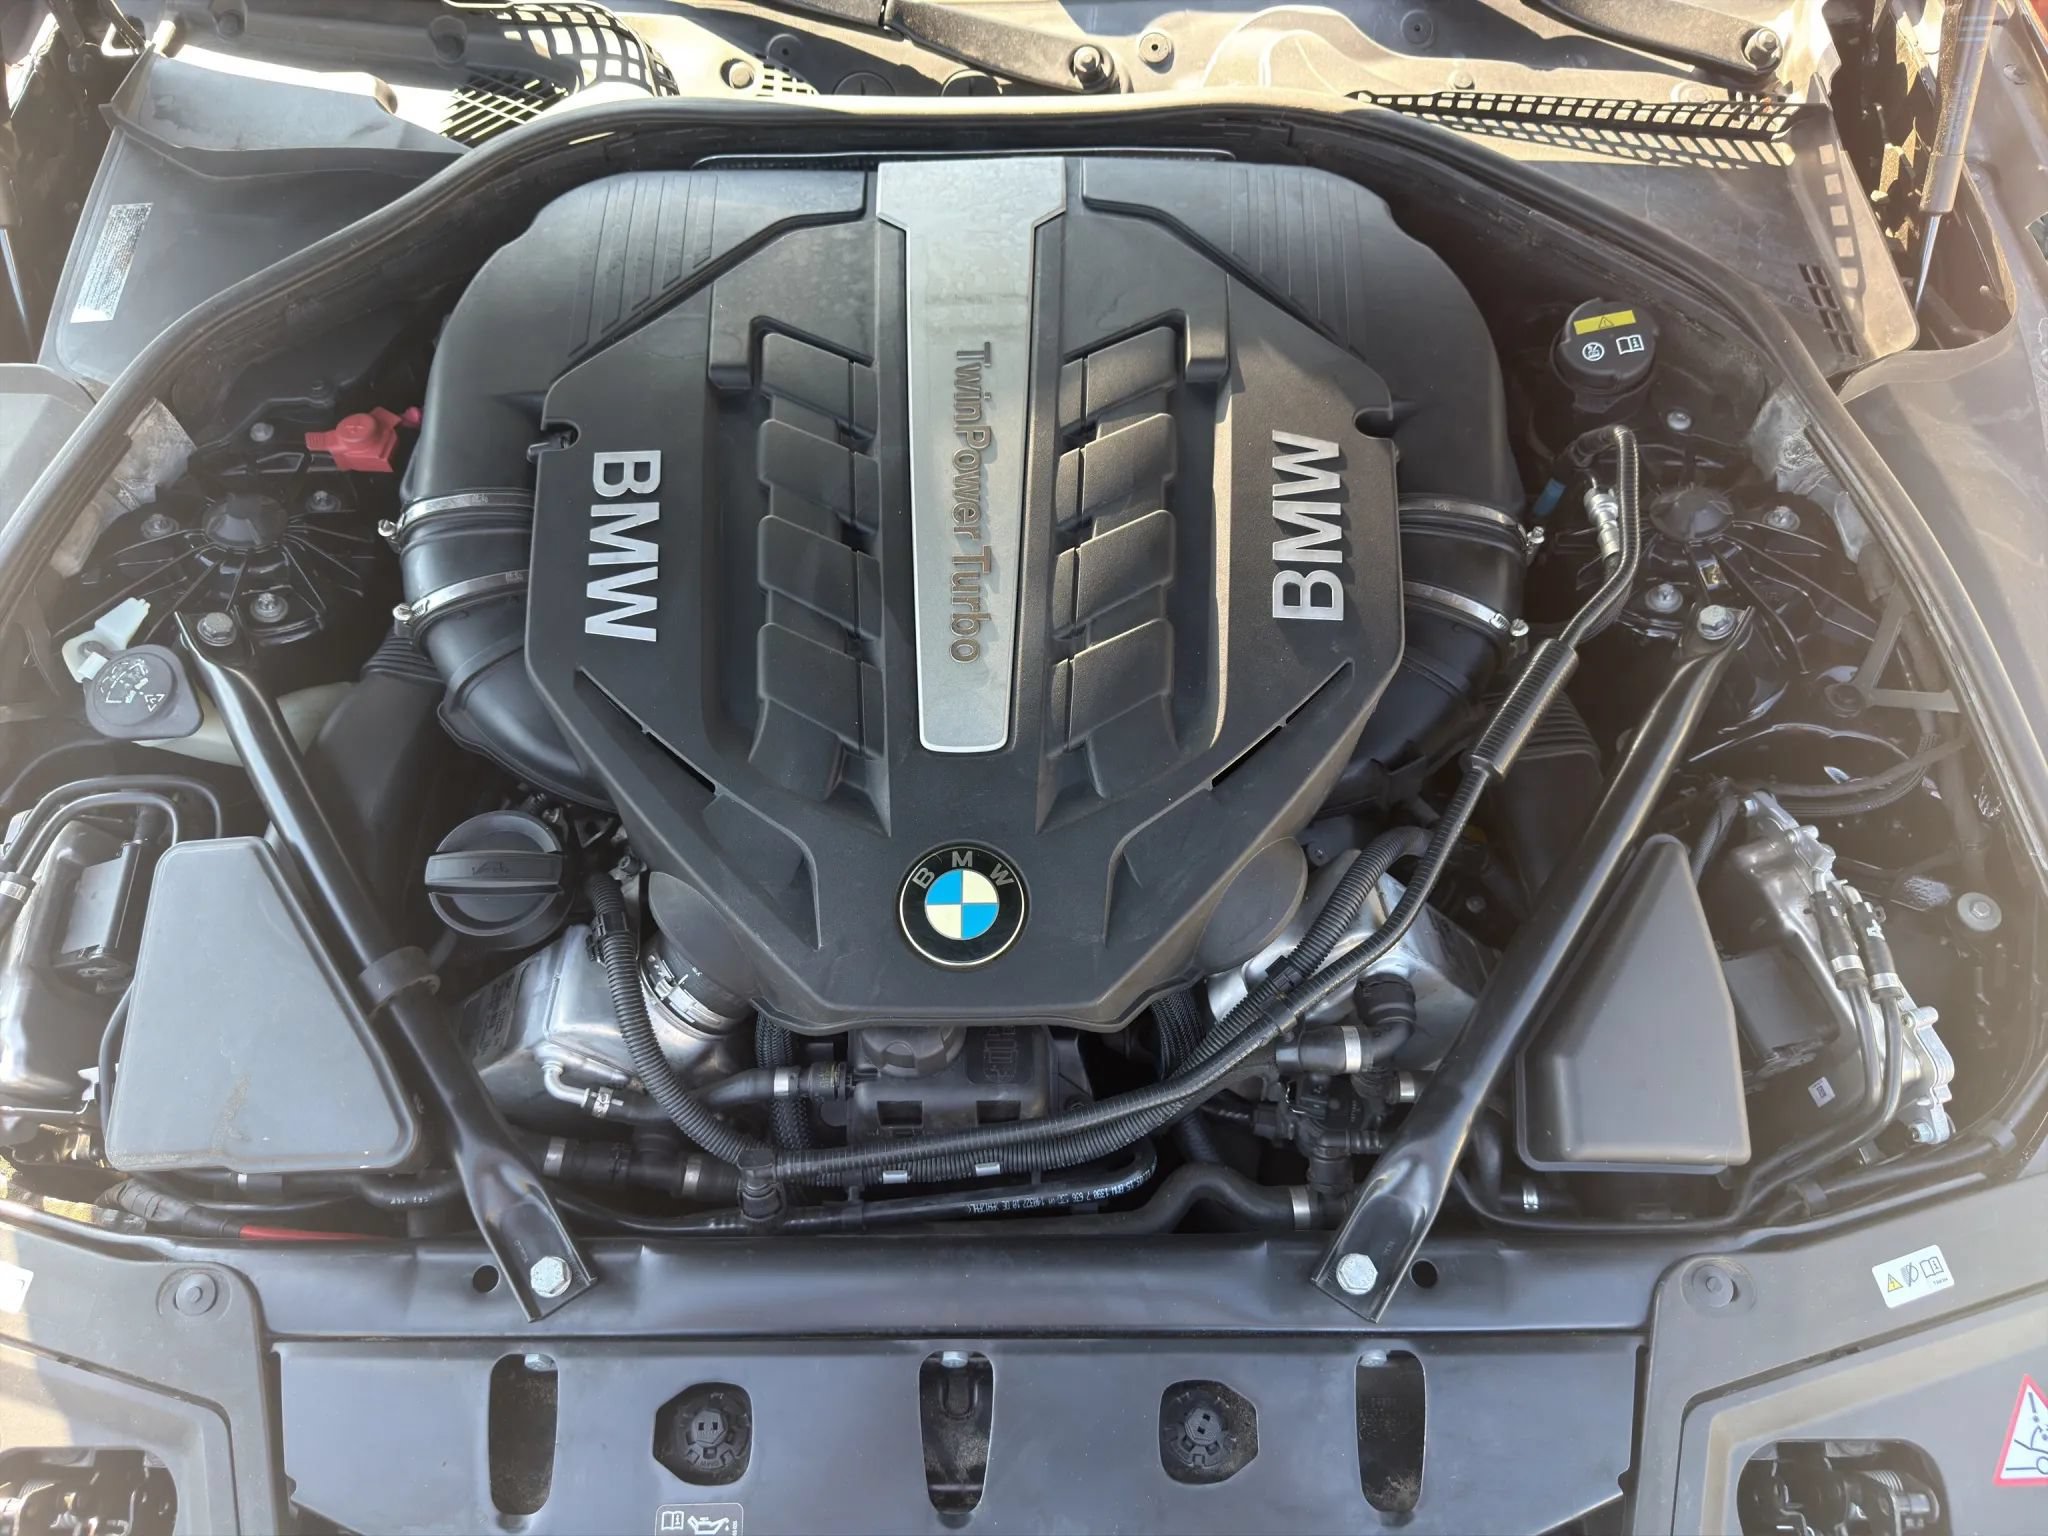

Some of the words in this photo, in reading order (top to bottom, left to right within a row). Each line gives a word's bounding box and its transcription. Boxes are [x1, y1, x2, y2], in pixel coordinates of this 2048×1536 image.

[952, 341, 992, 540] TwinPower
[1271, 430, 1343, 620] BMW
[584, 450, 662, 642] BMW
[949, 546, 991, 664] Turbo
[912, 850, 1014, 889] BMW
